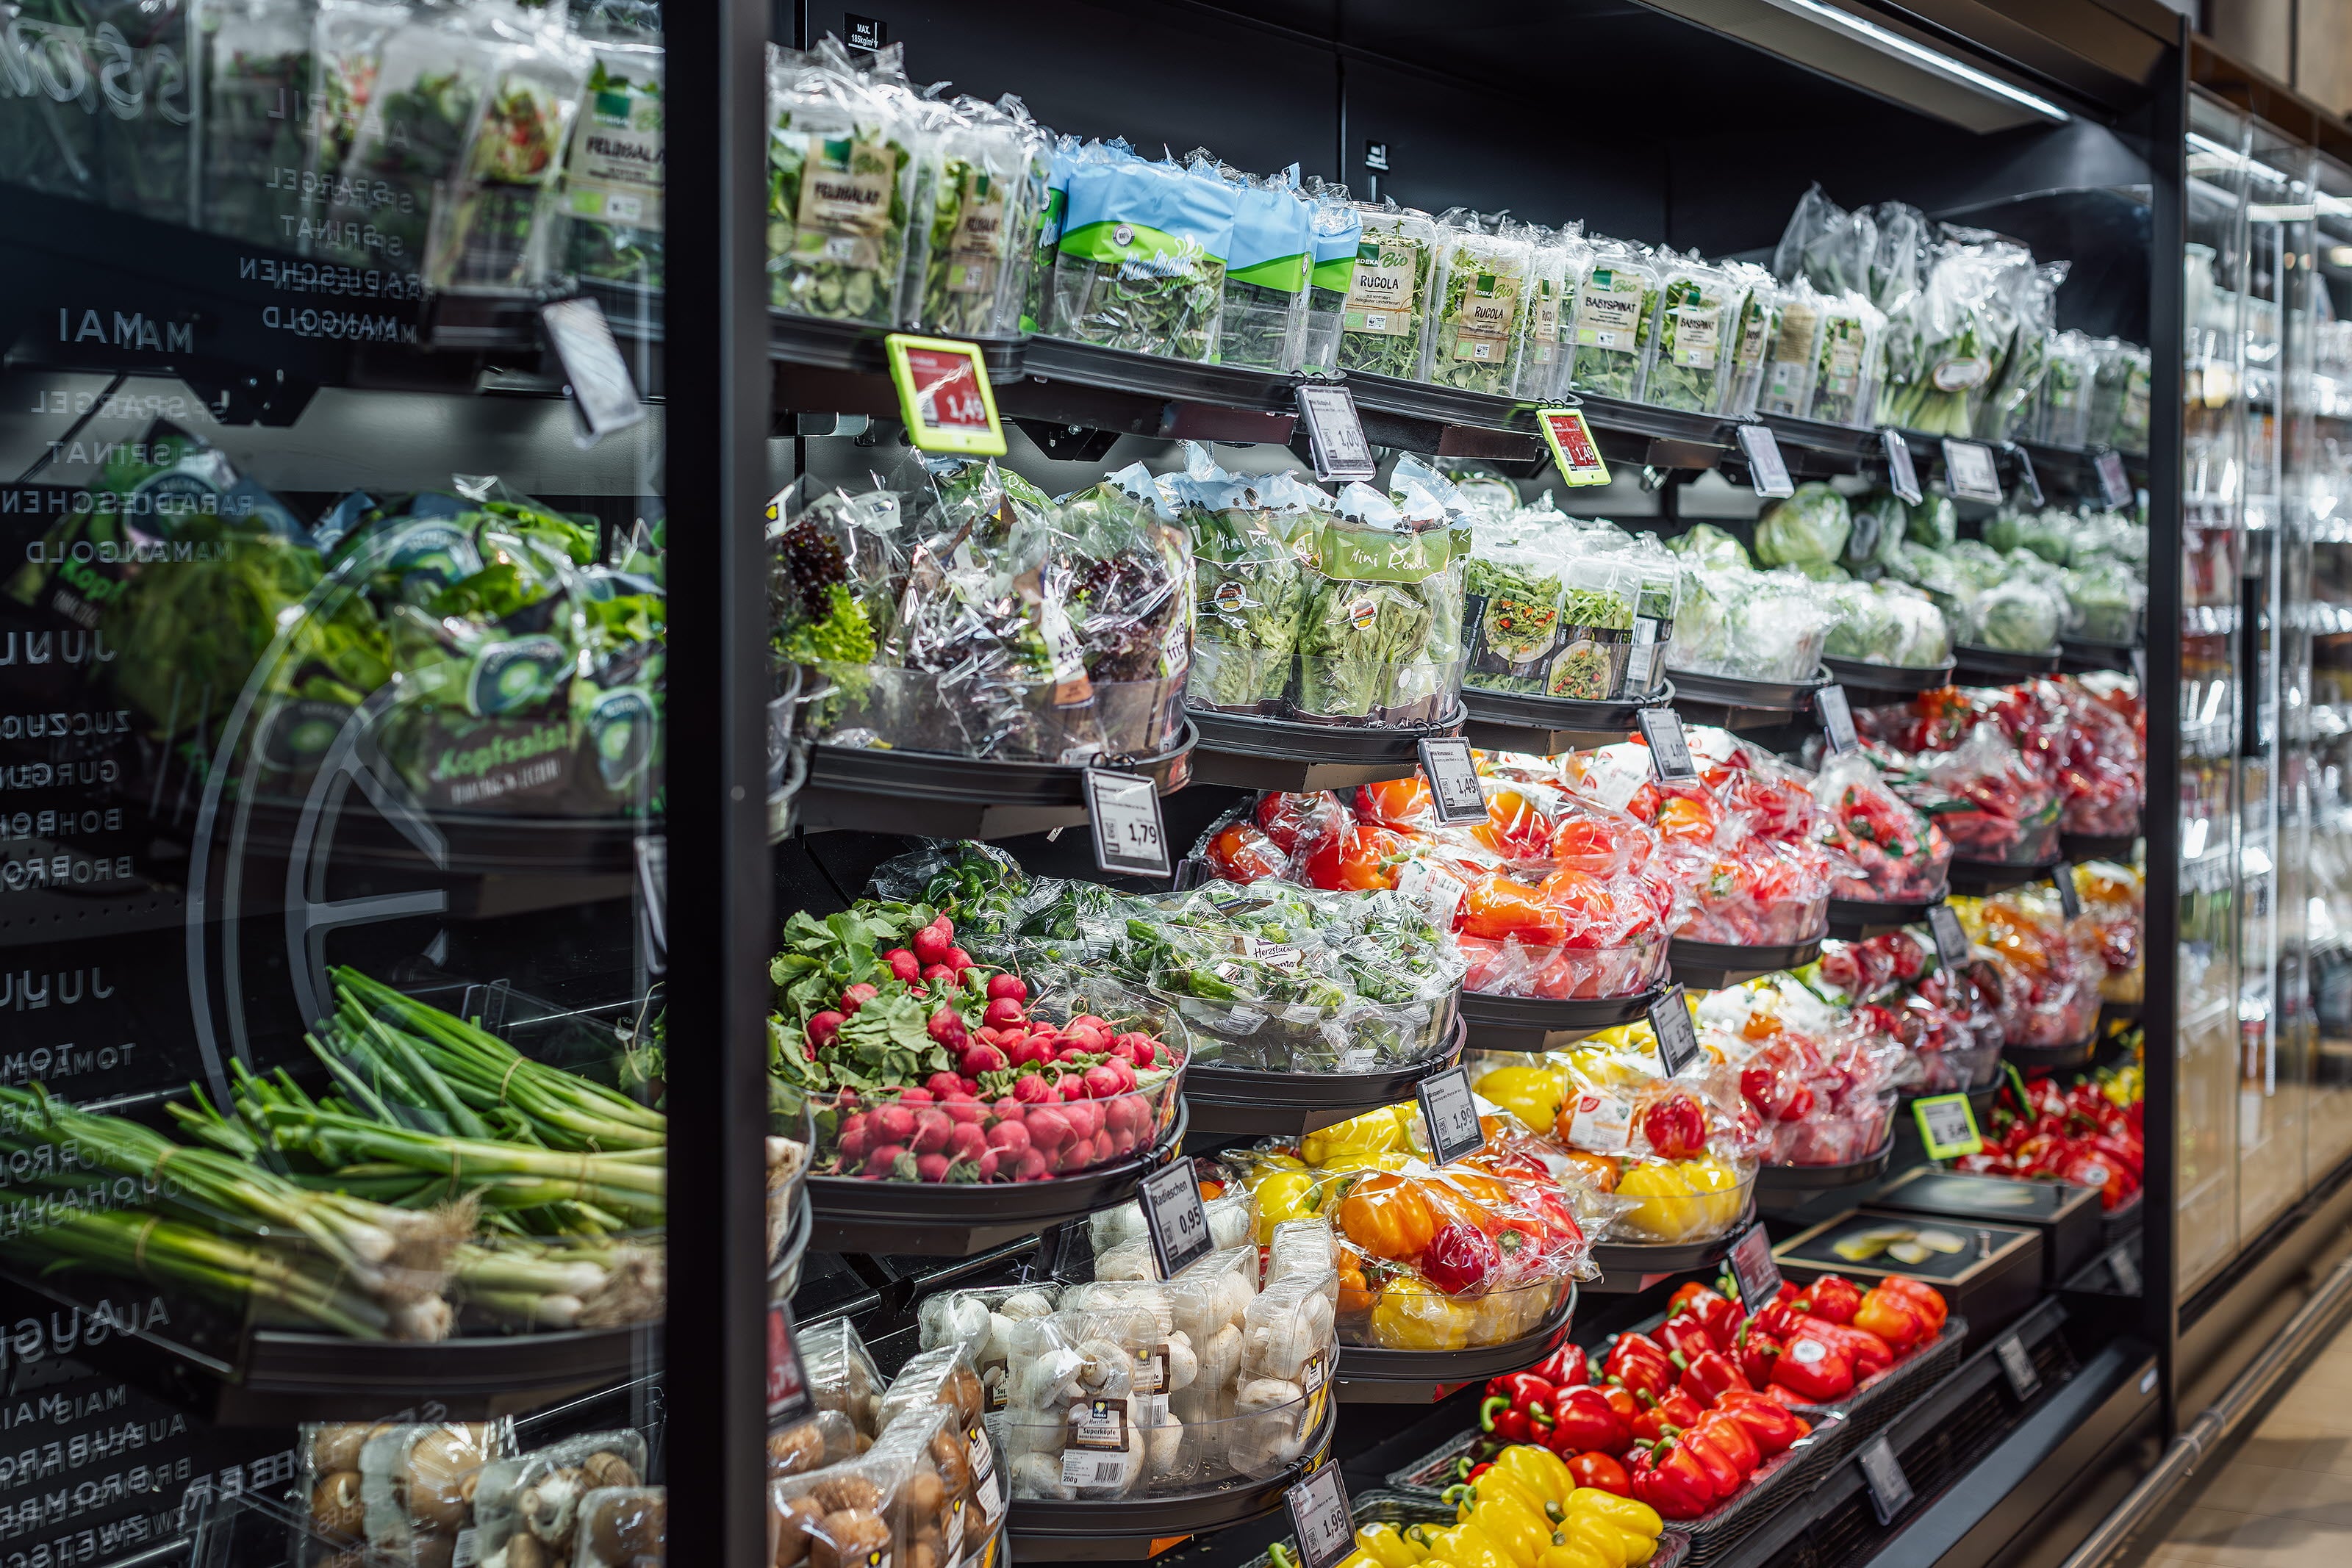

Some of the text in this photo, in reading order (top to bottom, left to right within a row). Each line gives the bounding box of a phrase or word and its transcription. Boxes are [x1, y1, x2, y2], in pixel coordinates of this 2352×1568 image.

[857, 24, 871, 35] MAX.
[1116, 248, 1194, 281] Italian
[1355, 251, 1409, 269] EDEKA Bio
[1360, 275, 1399, 289] RUCOLA
[1494, 283, 1513, 300] Bio
[1474, 306, 1504, 320] RUCOLA
[1585, 296, 1637, 314] BABYSPINAT
[947, 394, 986, 422] 1,49
[1574, 445, 1596, 464] 1,49
[1216, 530, 1246, 551] Mini
[1349, 548, 1379, 567] Mini
[1455, 777, 1477, 798] 1,49
[1128, 822, 1158, 846] 1,79
[1453, 1107, 1474, 1132] 1,99
[1153, 1179, 1188, 1208] Radieschen
[1179, 1206, 1202, 1236] 0,95
[1083, 1428, 1116, 1436] Superköpfe
[1323, 1508, 1345, 1539] 1,99
